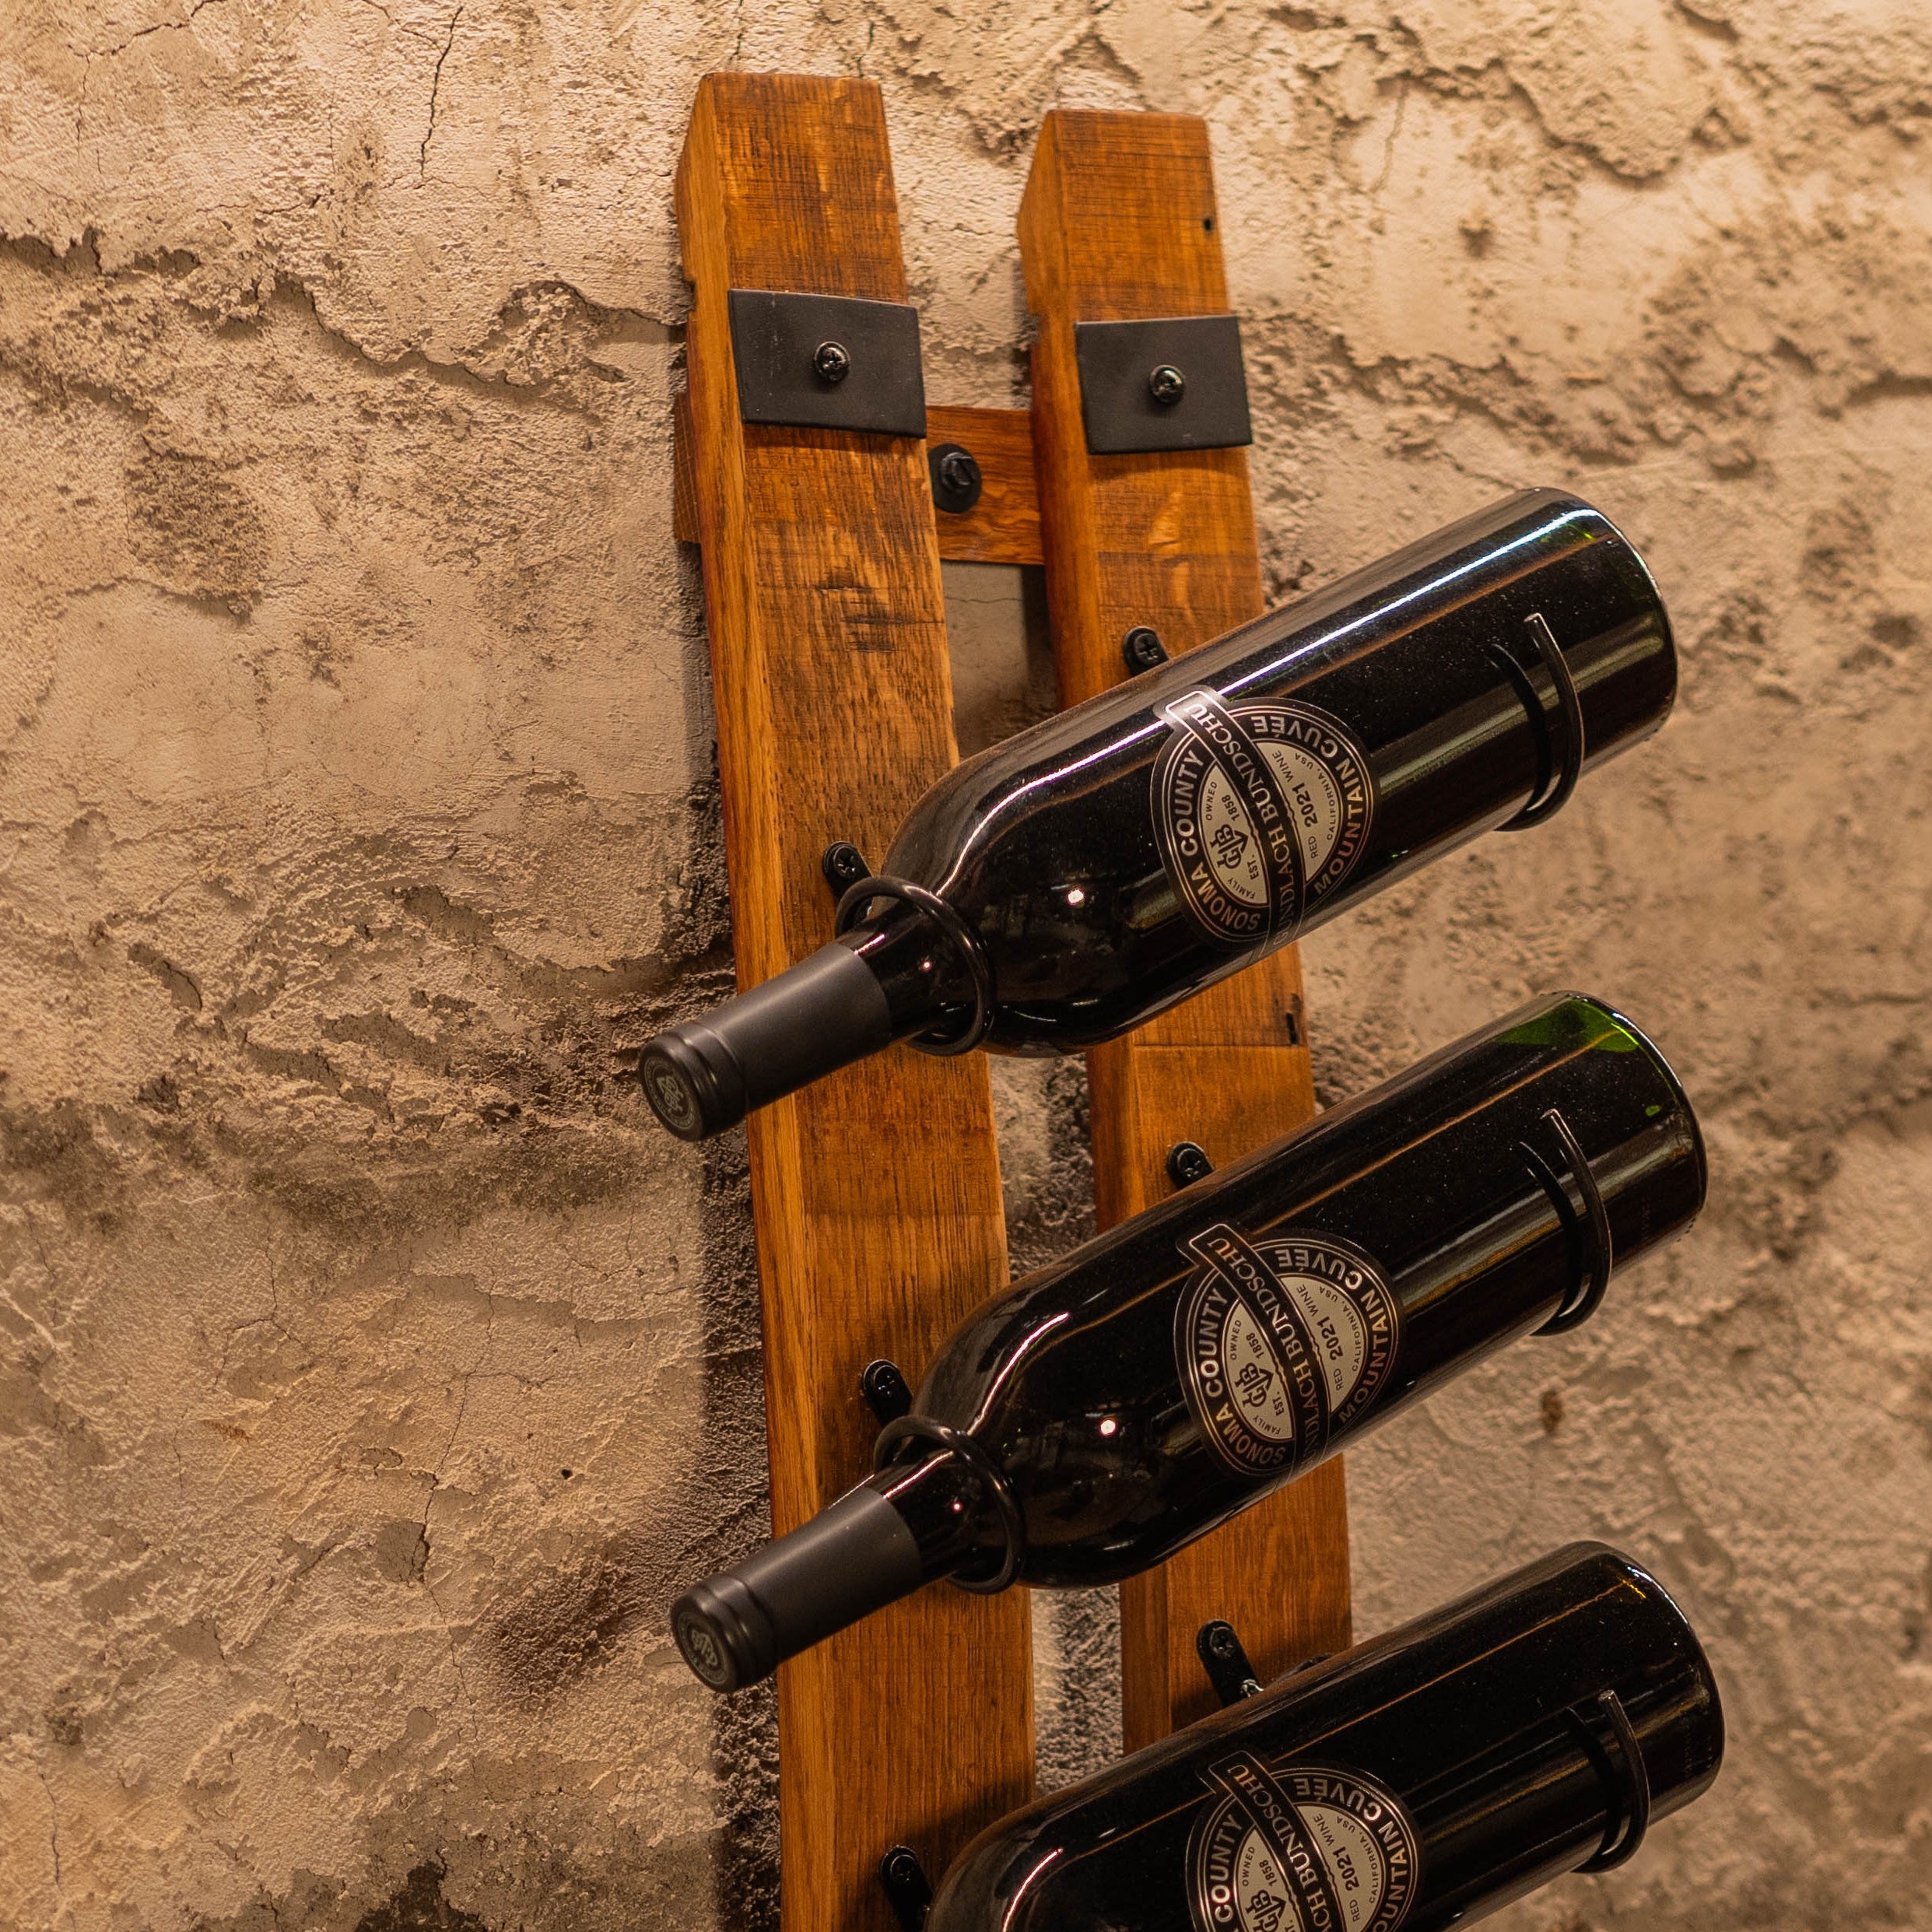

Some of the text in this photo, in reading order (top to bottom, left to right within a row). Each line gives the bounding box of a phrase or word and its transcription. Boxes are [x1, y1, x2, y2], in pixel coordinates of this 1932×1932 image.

[1185, 702, 1279, 825] BUNDSCHU
[1222, 794, 1240, 821] 1858
[1250, 715, 1363, 895] MOUNTAIN CUVÉE
[1272, 751, 1295, 783] WINE
[1291, 782, 1318, 828] 2021
[1295, 752, 1313, 770] USA
[1174, 749, 1261, 931] SONOMA COUNTY
[1206, 780, 1256, 899] FAMILY OWNED
[1207, 1238, 1303, 1359] BUNDSCHU
[1246, 1332, 1264, 1359] 1858
[1275, 1249, 1389, 1424] MOUNTAIN CUVÉE
[1296, 1284, 1344, 1391] RED 2021 WINE
[1319, 1286, 1338, 1302] USA
[1198, 1288, 1285, 1464] SONOMA COUNTY
[1231, 1319, 1281, 1435] FAMILY OWNED
[1227, 1764, 1319, 1889] BUNDSCHU
[1293, 1777, 1382, 1821] CUVÉE
[1336, 1817, 1355, 1833] USA
[1210, 1814, 1243, 1923] COUNTY
[1242, 1846, 1255, 1887] OWNED
[1259, 1859, 1278, 1887] 1858
[1313, 1814, 1360, 1922] RED 2021 WINE
[1372, 1821, 1408, 1932] OUNTAIN
